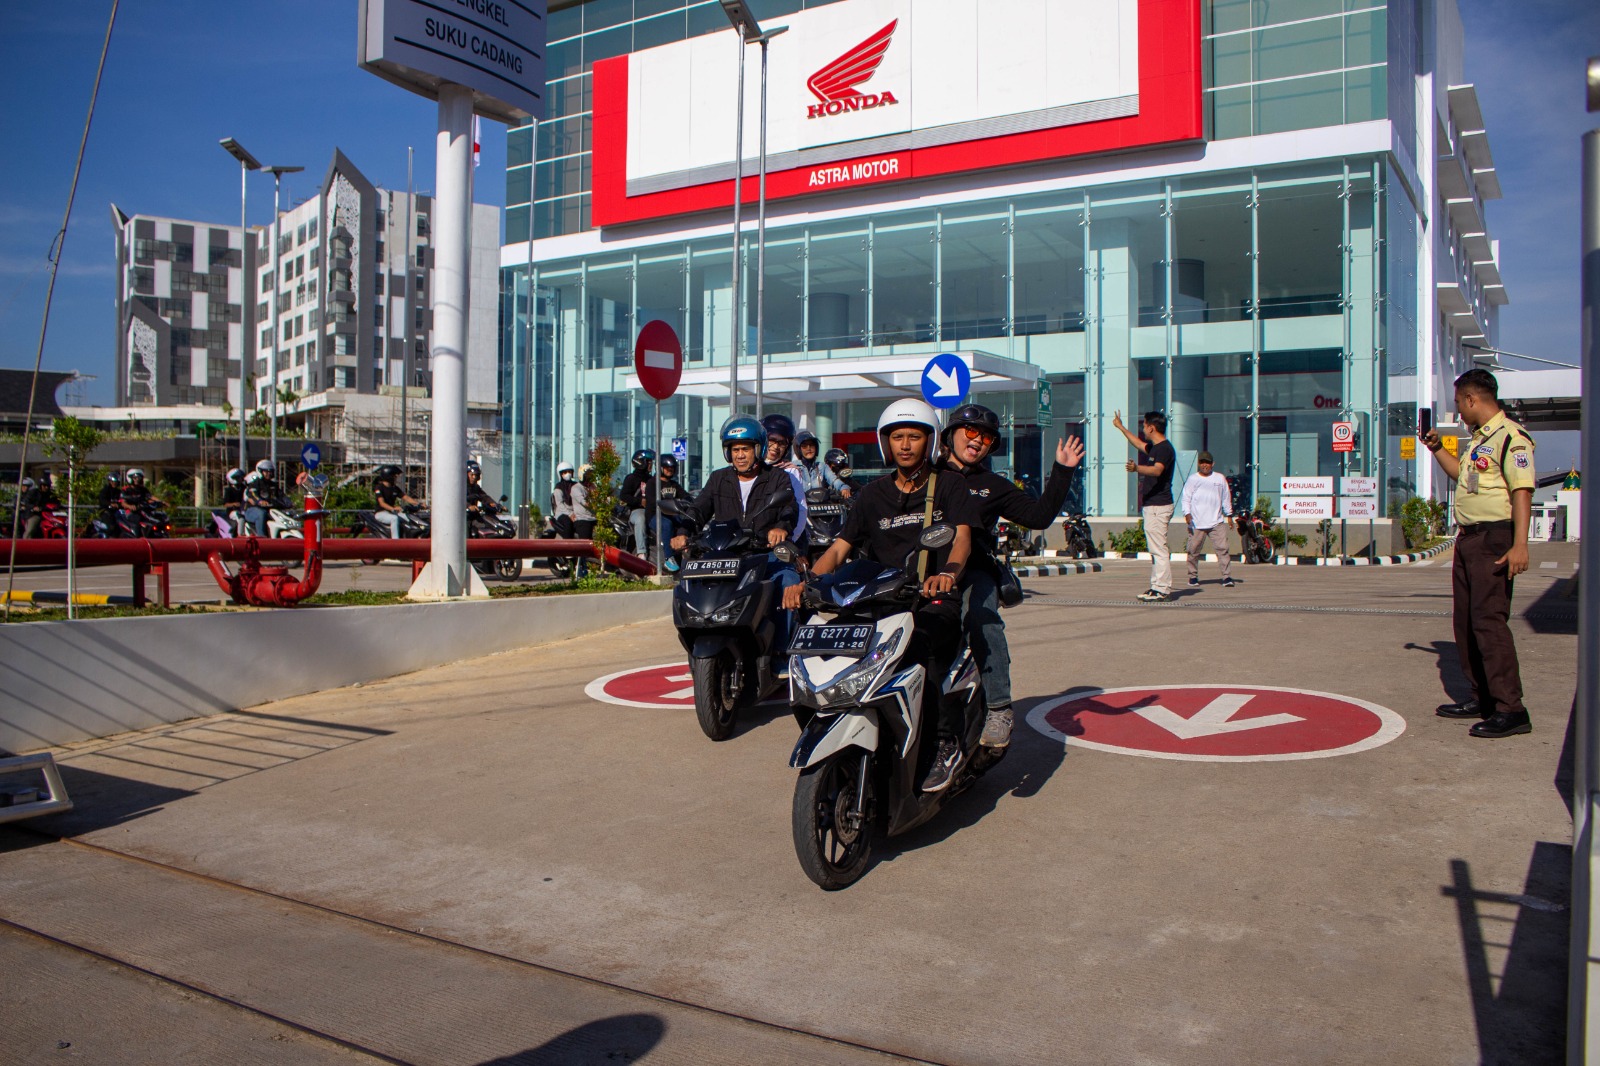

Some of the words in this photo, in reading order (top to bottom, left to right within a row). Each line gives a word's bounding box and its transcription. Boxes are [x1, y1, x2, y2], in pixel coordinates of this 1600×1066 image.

[457, 0, 509, 27] NGKEL
[425, 18, 467, 48] SUKU
[471, 36, 523, 75] CADANG
[807, 91, 898, 119] HONDA
[809, 166, 850, 186] ASTRA
[853, 158, 898, 181] MOTOR
[673, 440, 680, 452] P
[687, 562, 698, 570] KB
[701, 561, 722, 569] 4850
[798, 628, 815, 639] KB
[821, 627, 850, 639] 6277
[908, 674, 922, 691] HONDA
